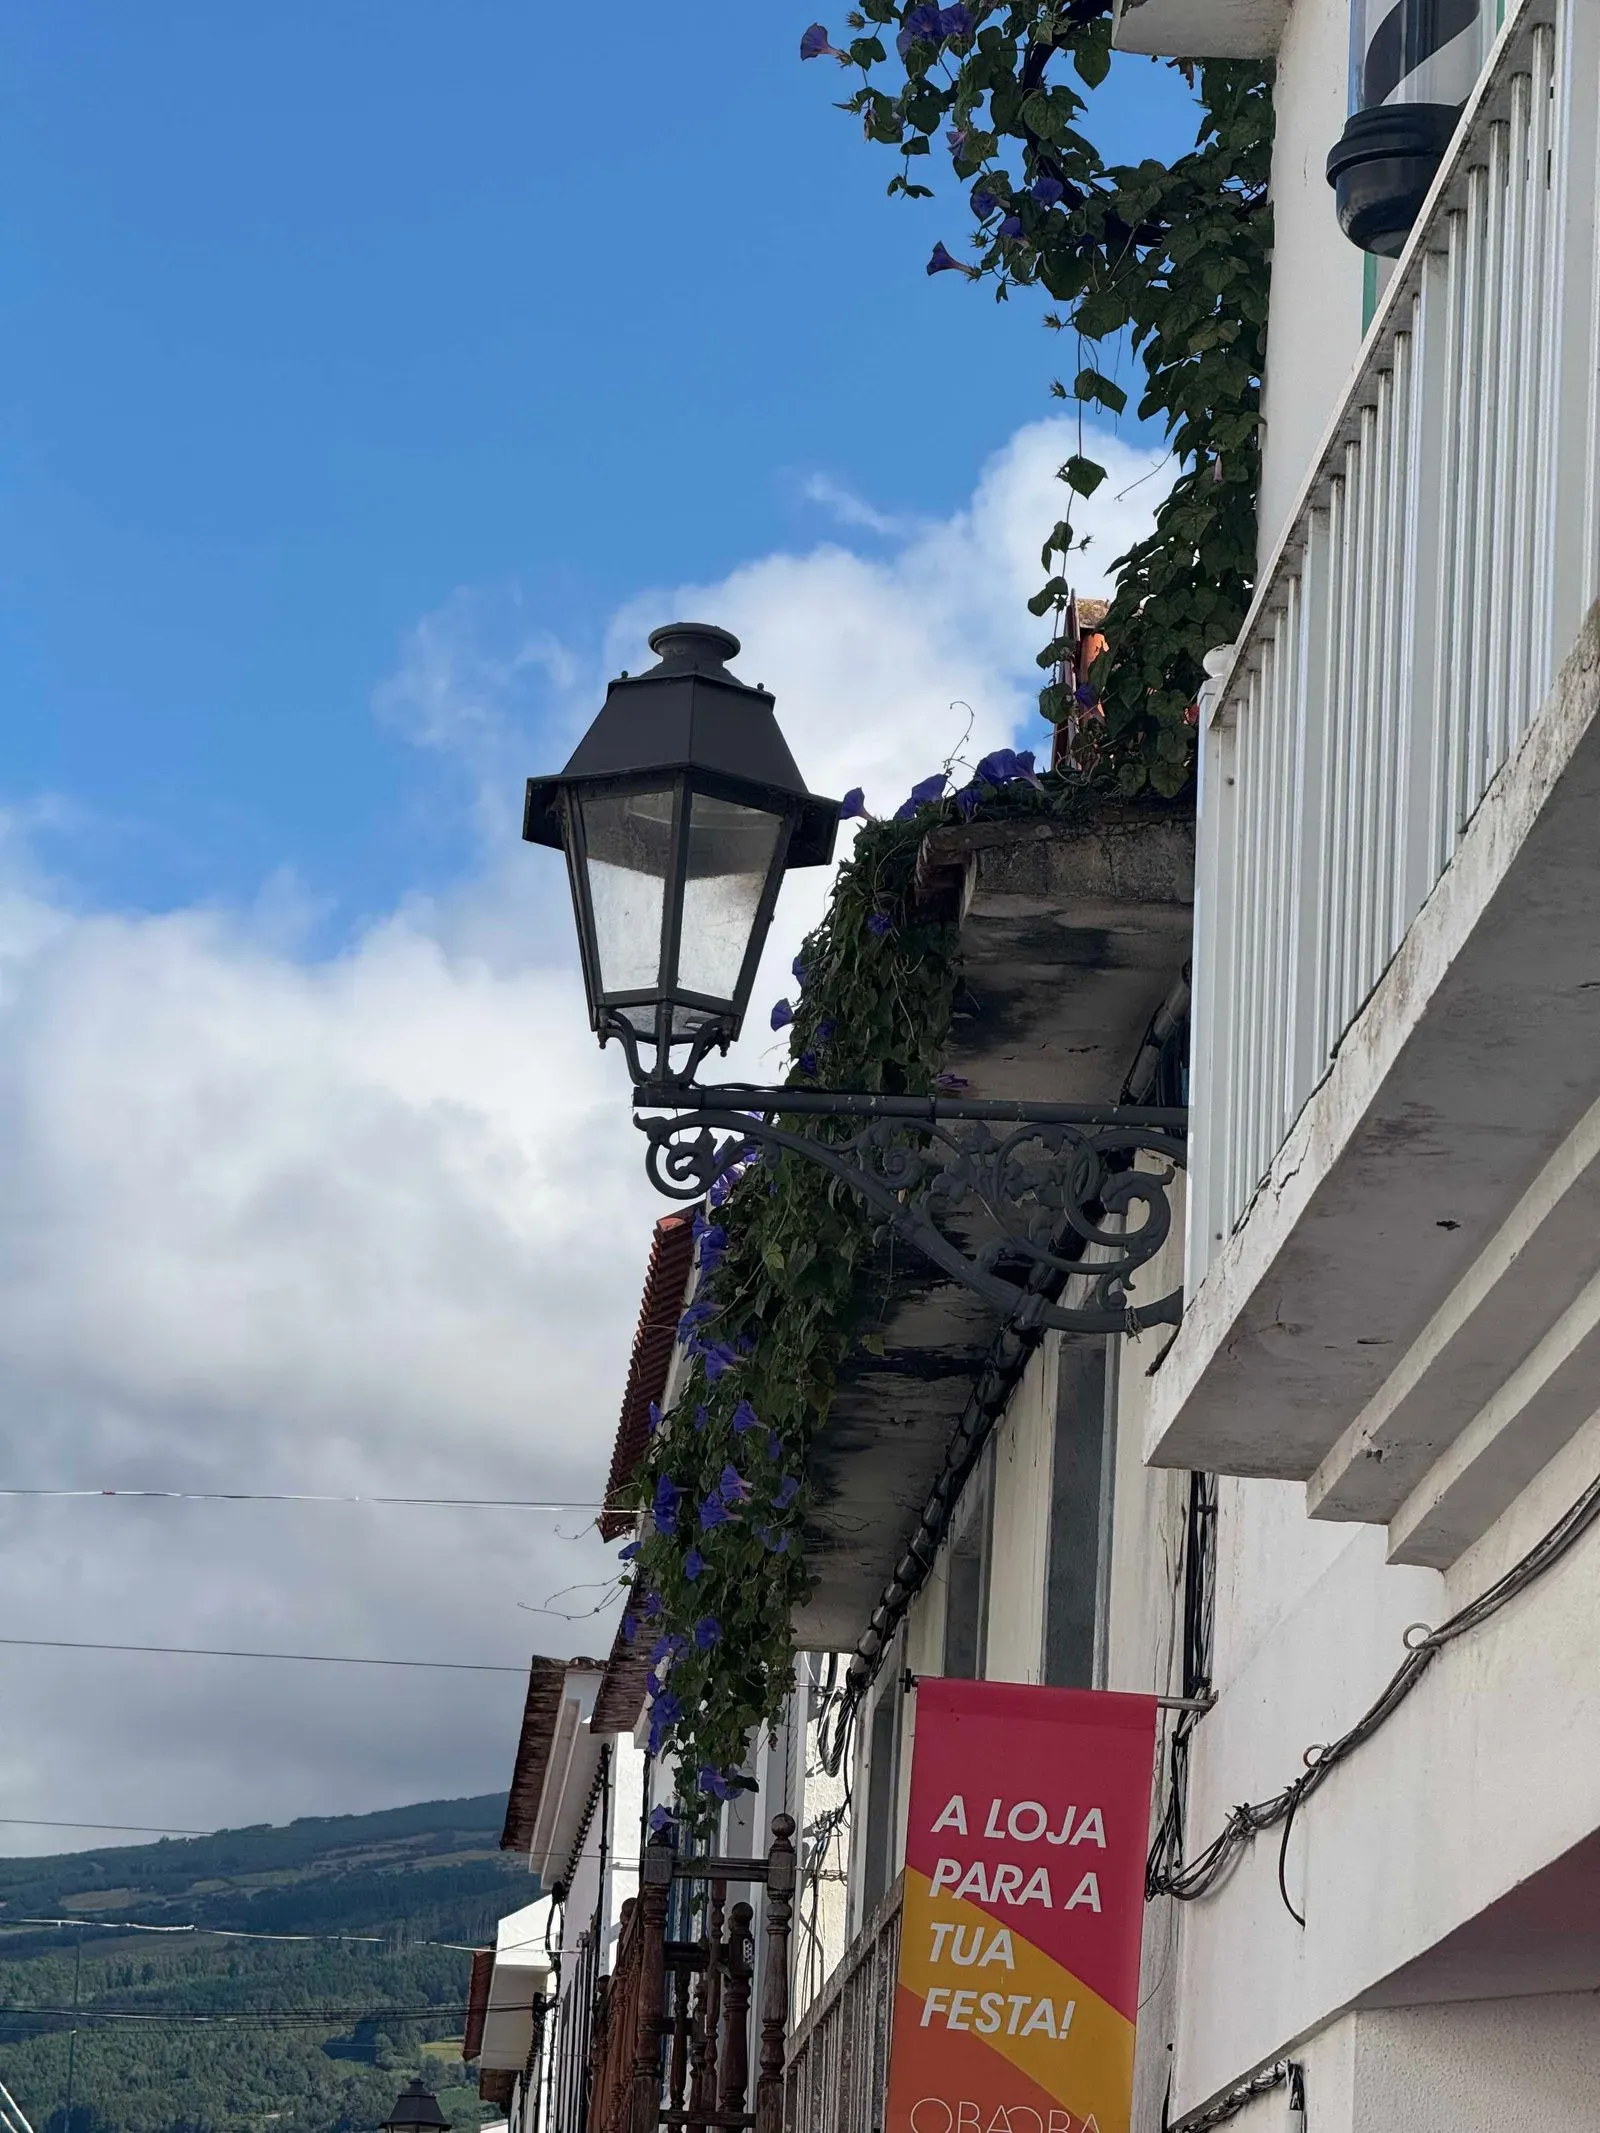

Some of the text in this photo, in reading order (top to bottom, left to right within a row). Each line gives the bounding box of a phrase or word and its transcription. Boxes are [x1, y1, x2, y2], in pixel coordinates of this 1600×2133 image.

[930, 1795, 1107, 1849] A LOJA
[928, 1858, 1102, 1913] PARA A
[929, 1922, 1015, 1970] TUA
[919, 1988, 1076, 2040] FESTA!
